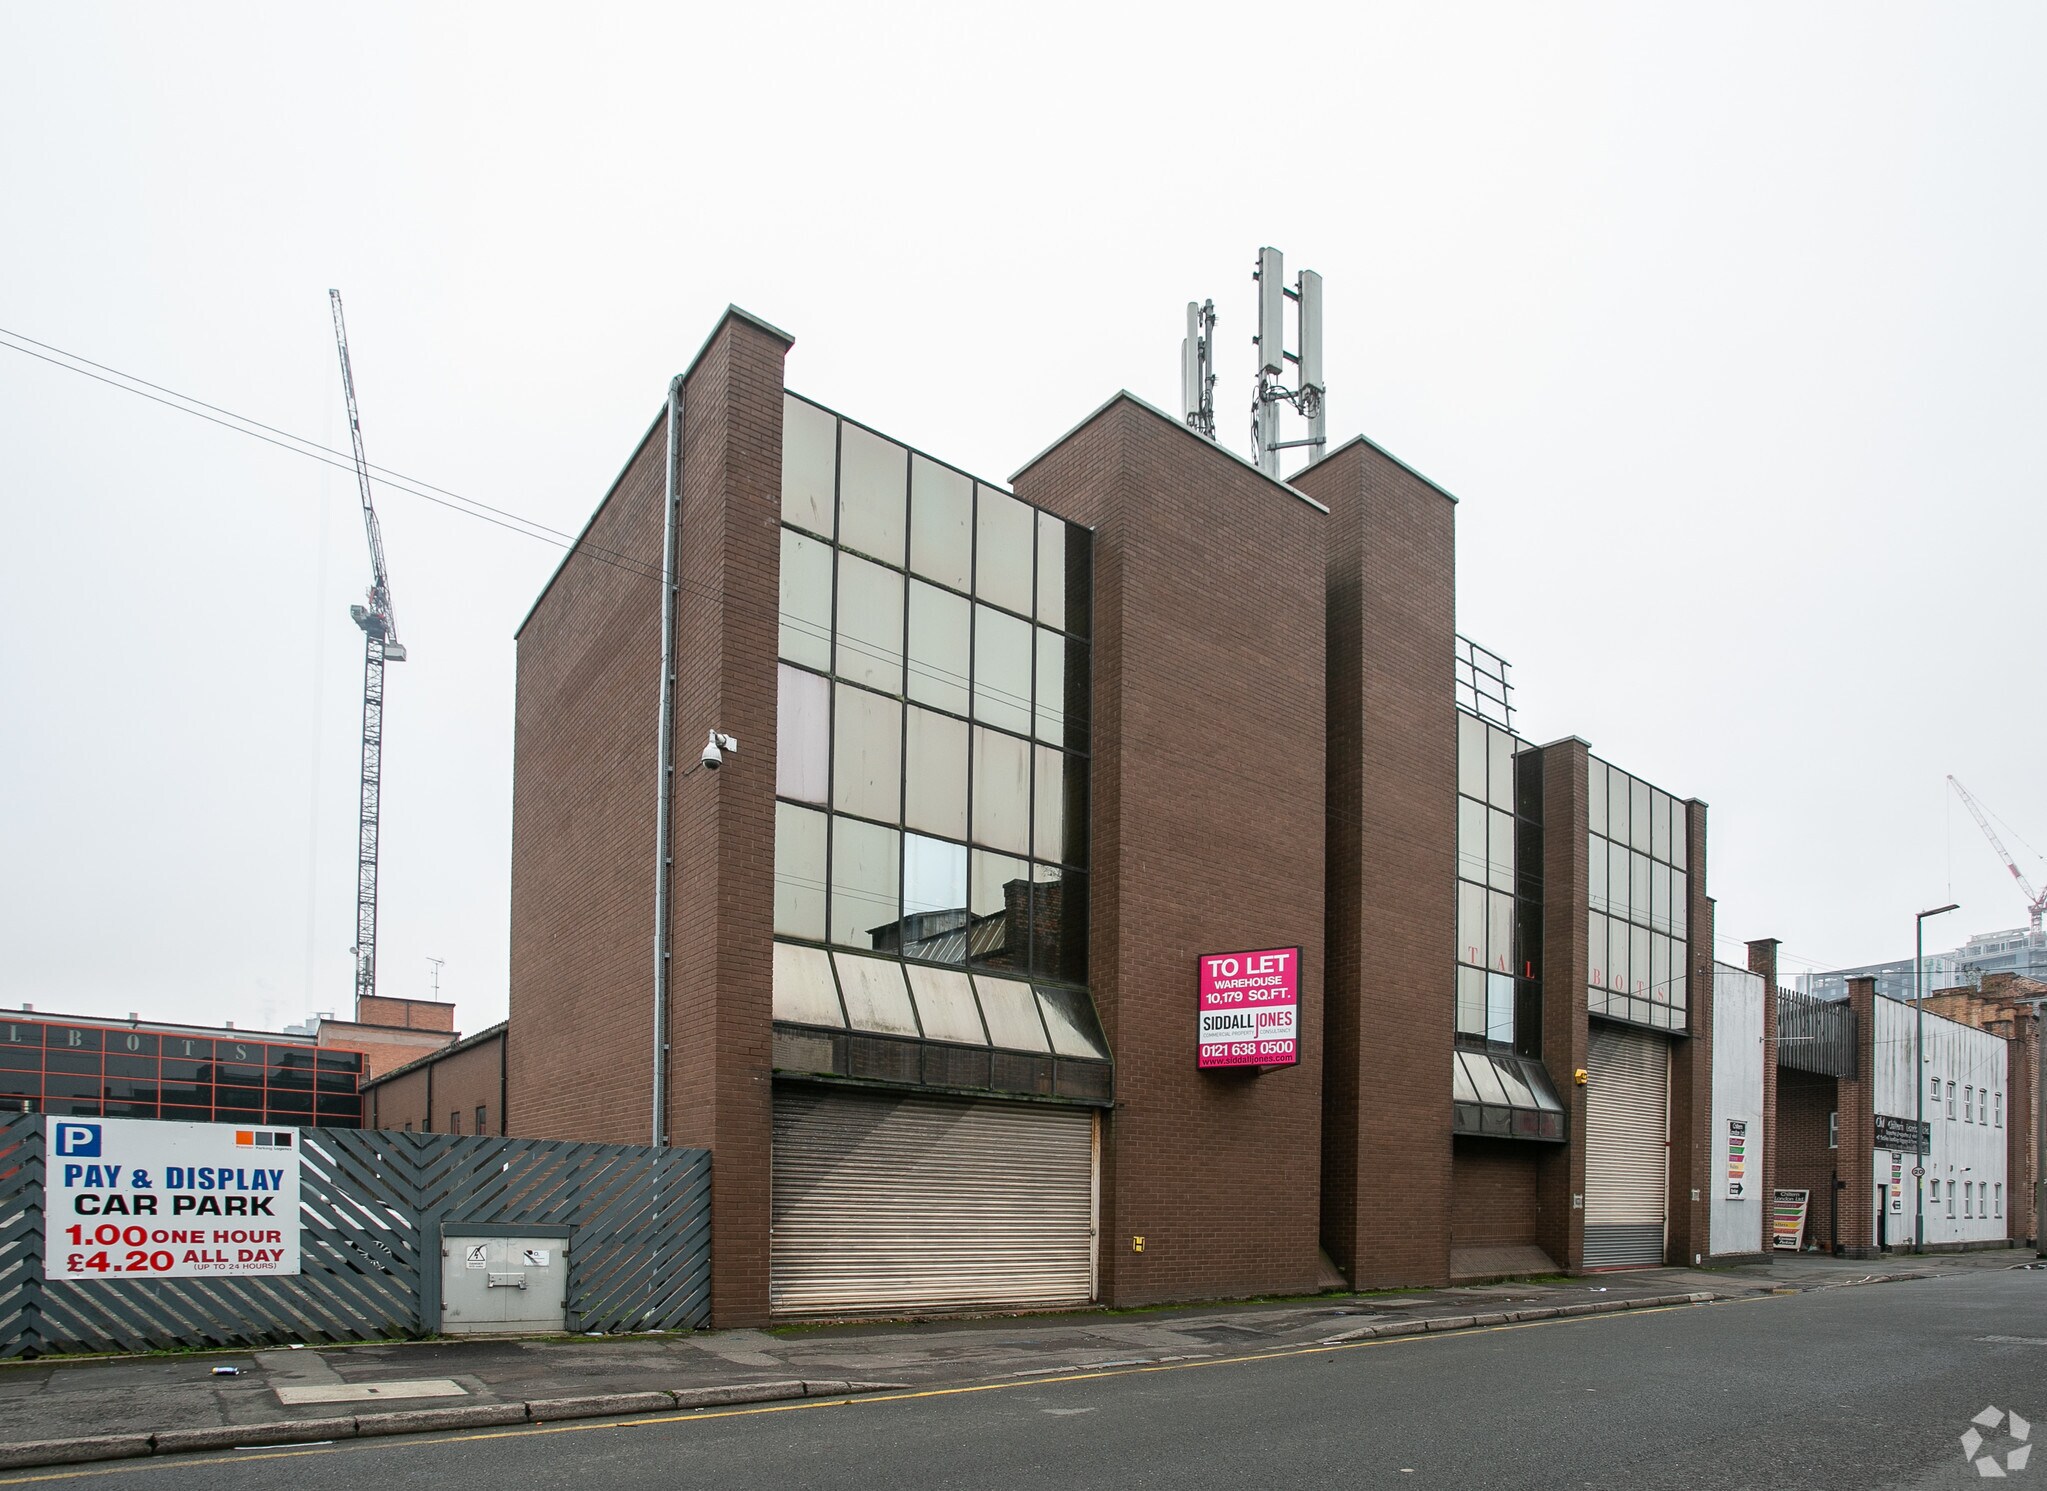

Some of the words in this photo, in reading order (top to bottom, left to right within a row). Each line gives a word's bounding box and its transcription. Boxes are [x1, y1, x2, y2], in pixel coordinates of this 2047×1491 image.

[1207, 958, 1239, 978] TO
[1246, 954, 1290, 975] LET
[1214, 976, 1282, 990] WAREHOUSE
[1206, 991, 1243, 1005] 10,179
[1248, 988, 1291, 1002] SQ.FT.
[1203, 1013, 1254, 1031] SIDDALL
[1254, 1011, 1292, 1039] JONES
[1231, 1029, 1254, 1037] PROPERTY
[1202, 1044, 1228, 1057] 0121
[1231, 1042, 1256, 1056] 638
[1260, 1041, 1293, 1054] 0500
[1202, 1055, 1293, 1066] www.siddalljones.com
[64, 1164, 121, 1188] PAY
[132, 1168, 153, 1189] &
[166, 1166, 284, 1190] DISPLAY
[74, 1194, 157, 1216] CAR
[173, 1195, 275, 1216] PARK
[65, 1224, 148, 1247] 1.00
[152, 1230, 205, 1243] ONE
[213, 1229, 281, 1243] HOUR
[67, 1250, 174, 1273] £4.20
[183, 1249, 229, 1263] ALL
[238, 1248, 285, 1263] DAY
[193, 1262, 212, 1271] (UP
[214, 1262, 227, 1270] TO
[242, 1262, 278, 1270] HOURS)
